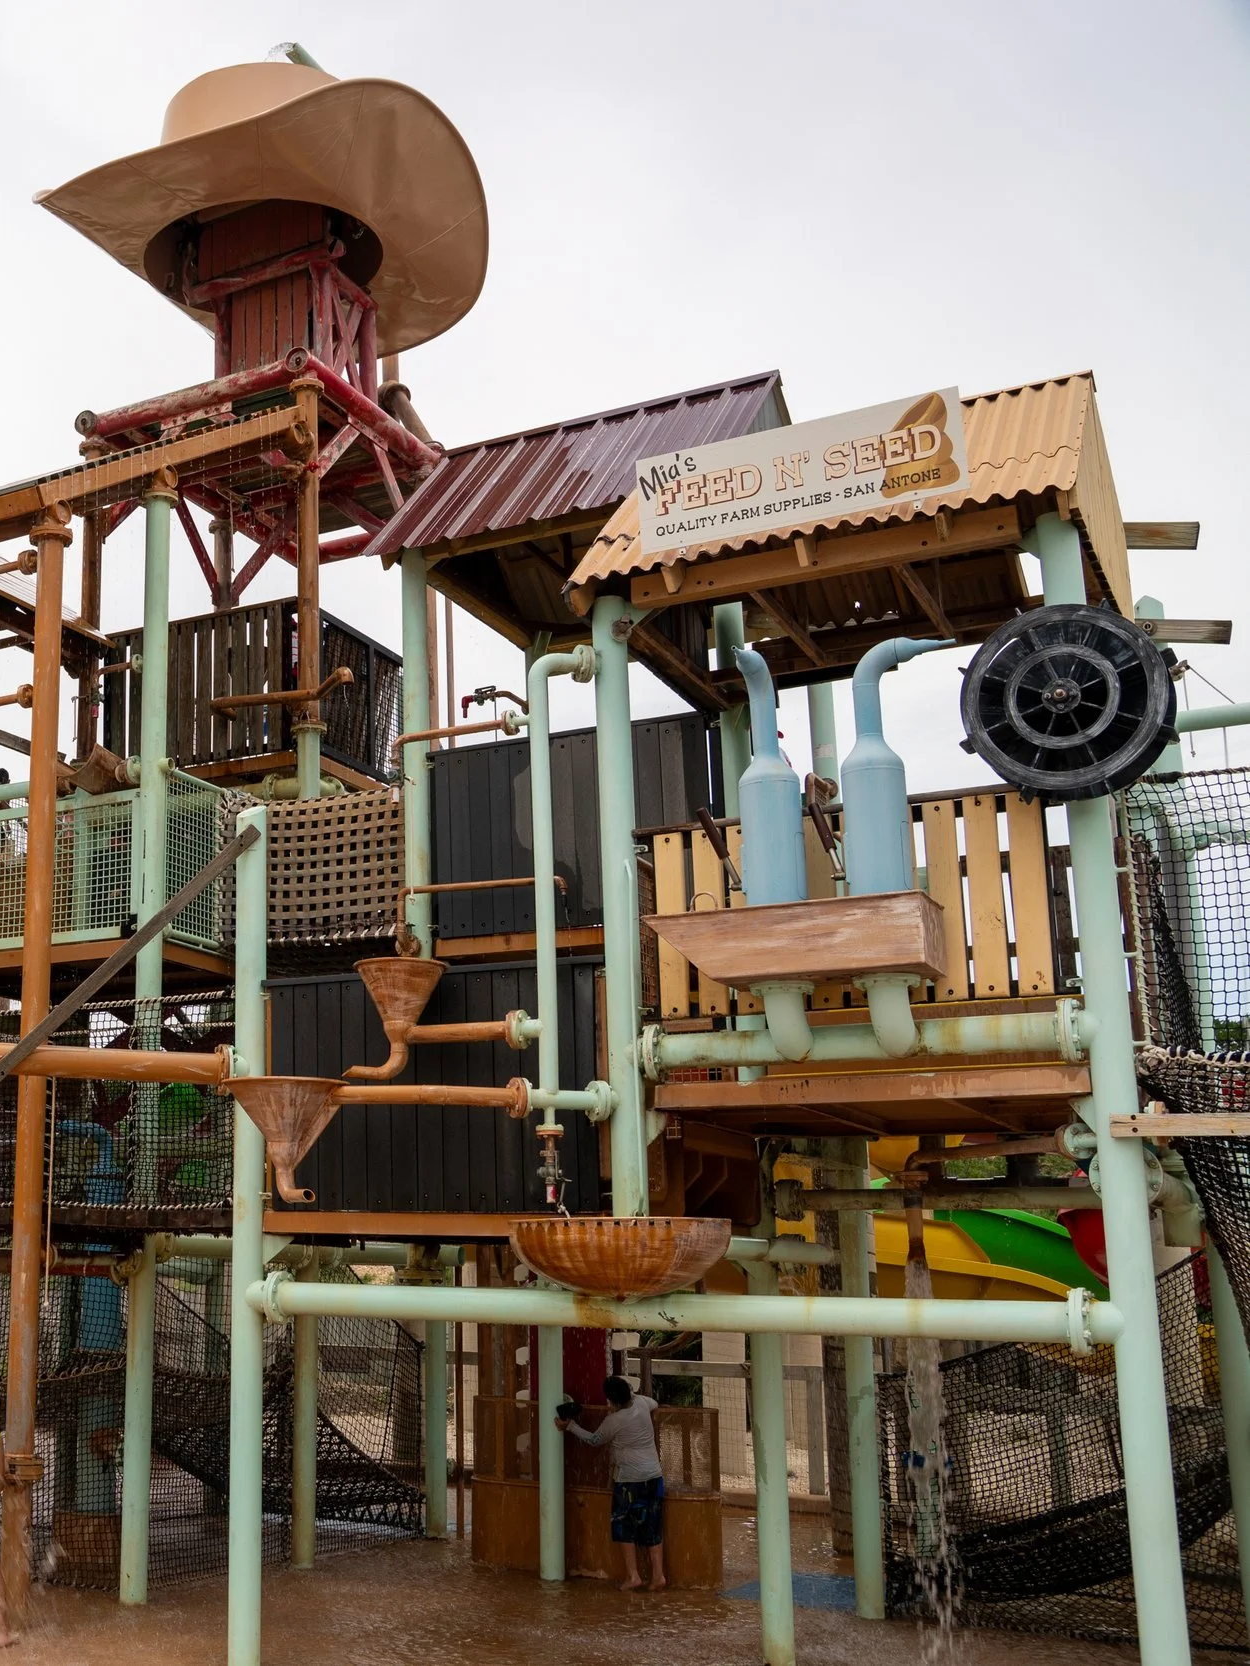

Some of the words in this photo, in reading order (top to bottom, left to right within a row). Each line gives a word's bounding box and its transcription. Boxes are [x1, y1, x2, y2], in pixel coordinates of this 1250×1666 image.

[639, 453, 697, 501] Mia's
[655, 464, 763, 516] FEED
[773, 450, 810, 491] N'
[823, 424, 942, 481] SEED
[656, 515, 717, 536] QUALITY
[721, 506, 760, 524] FARM
[763, 491, 832, 515] SUPPLIES
[843, 482, 875, 499] SAN
[879, 467, 941, 491] ANTONE
